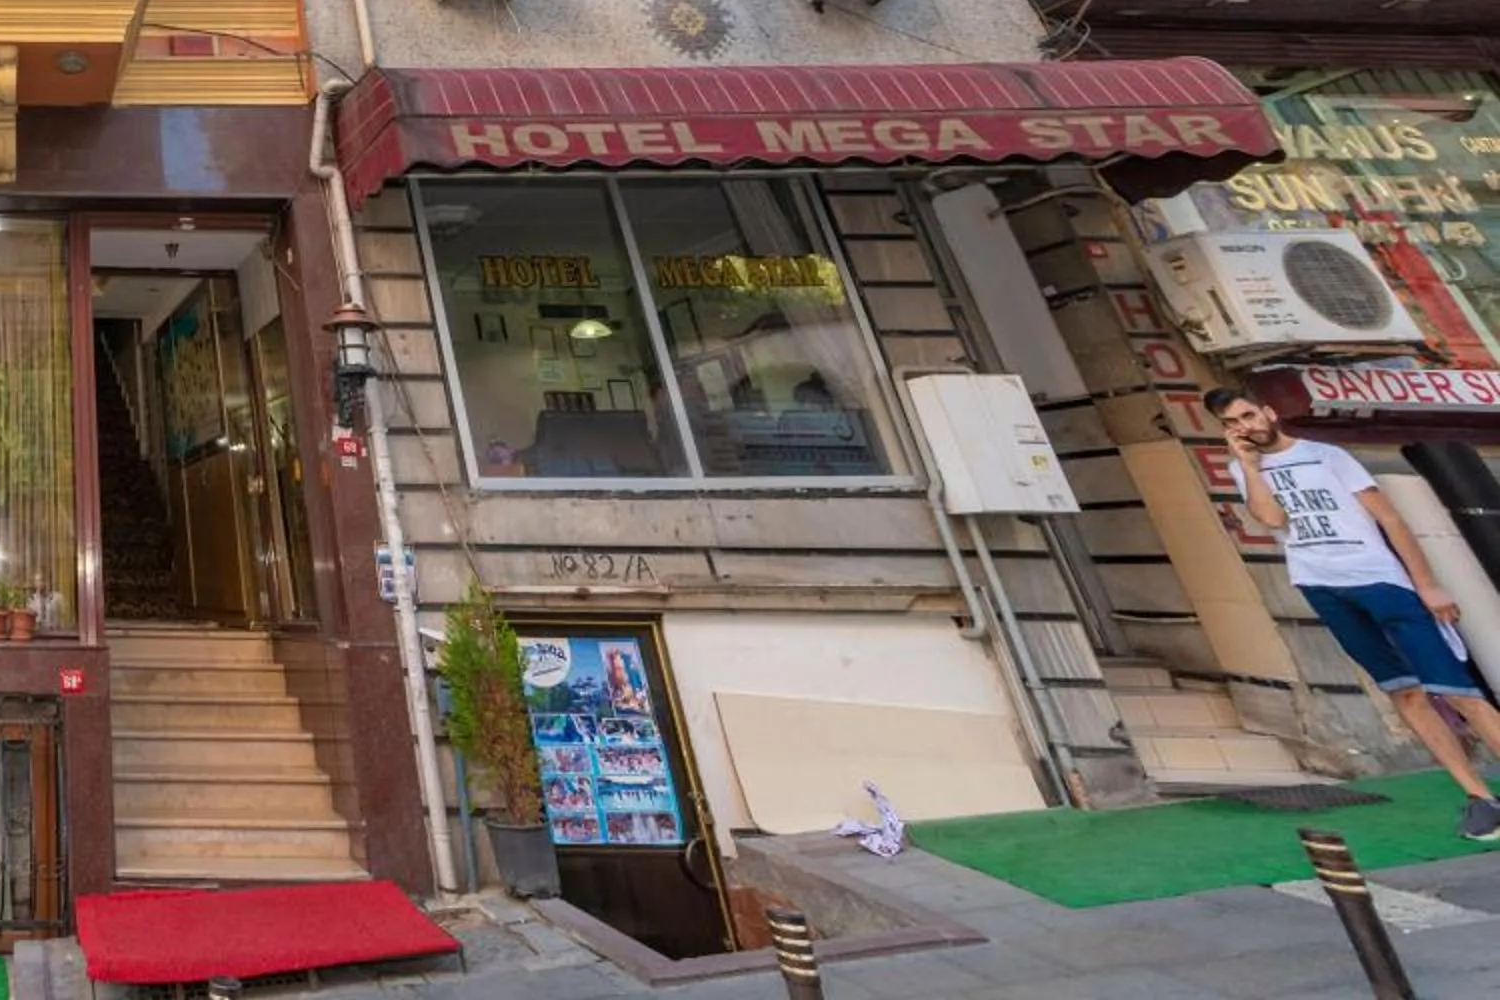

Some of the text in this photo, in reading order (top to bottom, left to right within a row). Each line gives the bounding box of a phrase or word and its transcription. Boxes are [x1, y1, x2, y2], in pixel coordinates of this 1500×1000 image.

[449, 114, 1237, 158] HOTEL MEGA STAR
[479, 255, 599, 289] HOTEL
[650, 255, 744, 288] MEGA
[1308, 367, 1465, 403] SAYDER
[1270, 469, 1297, 491] IN
[1273, 488, 1339, 514] RANG
